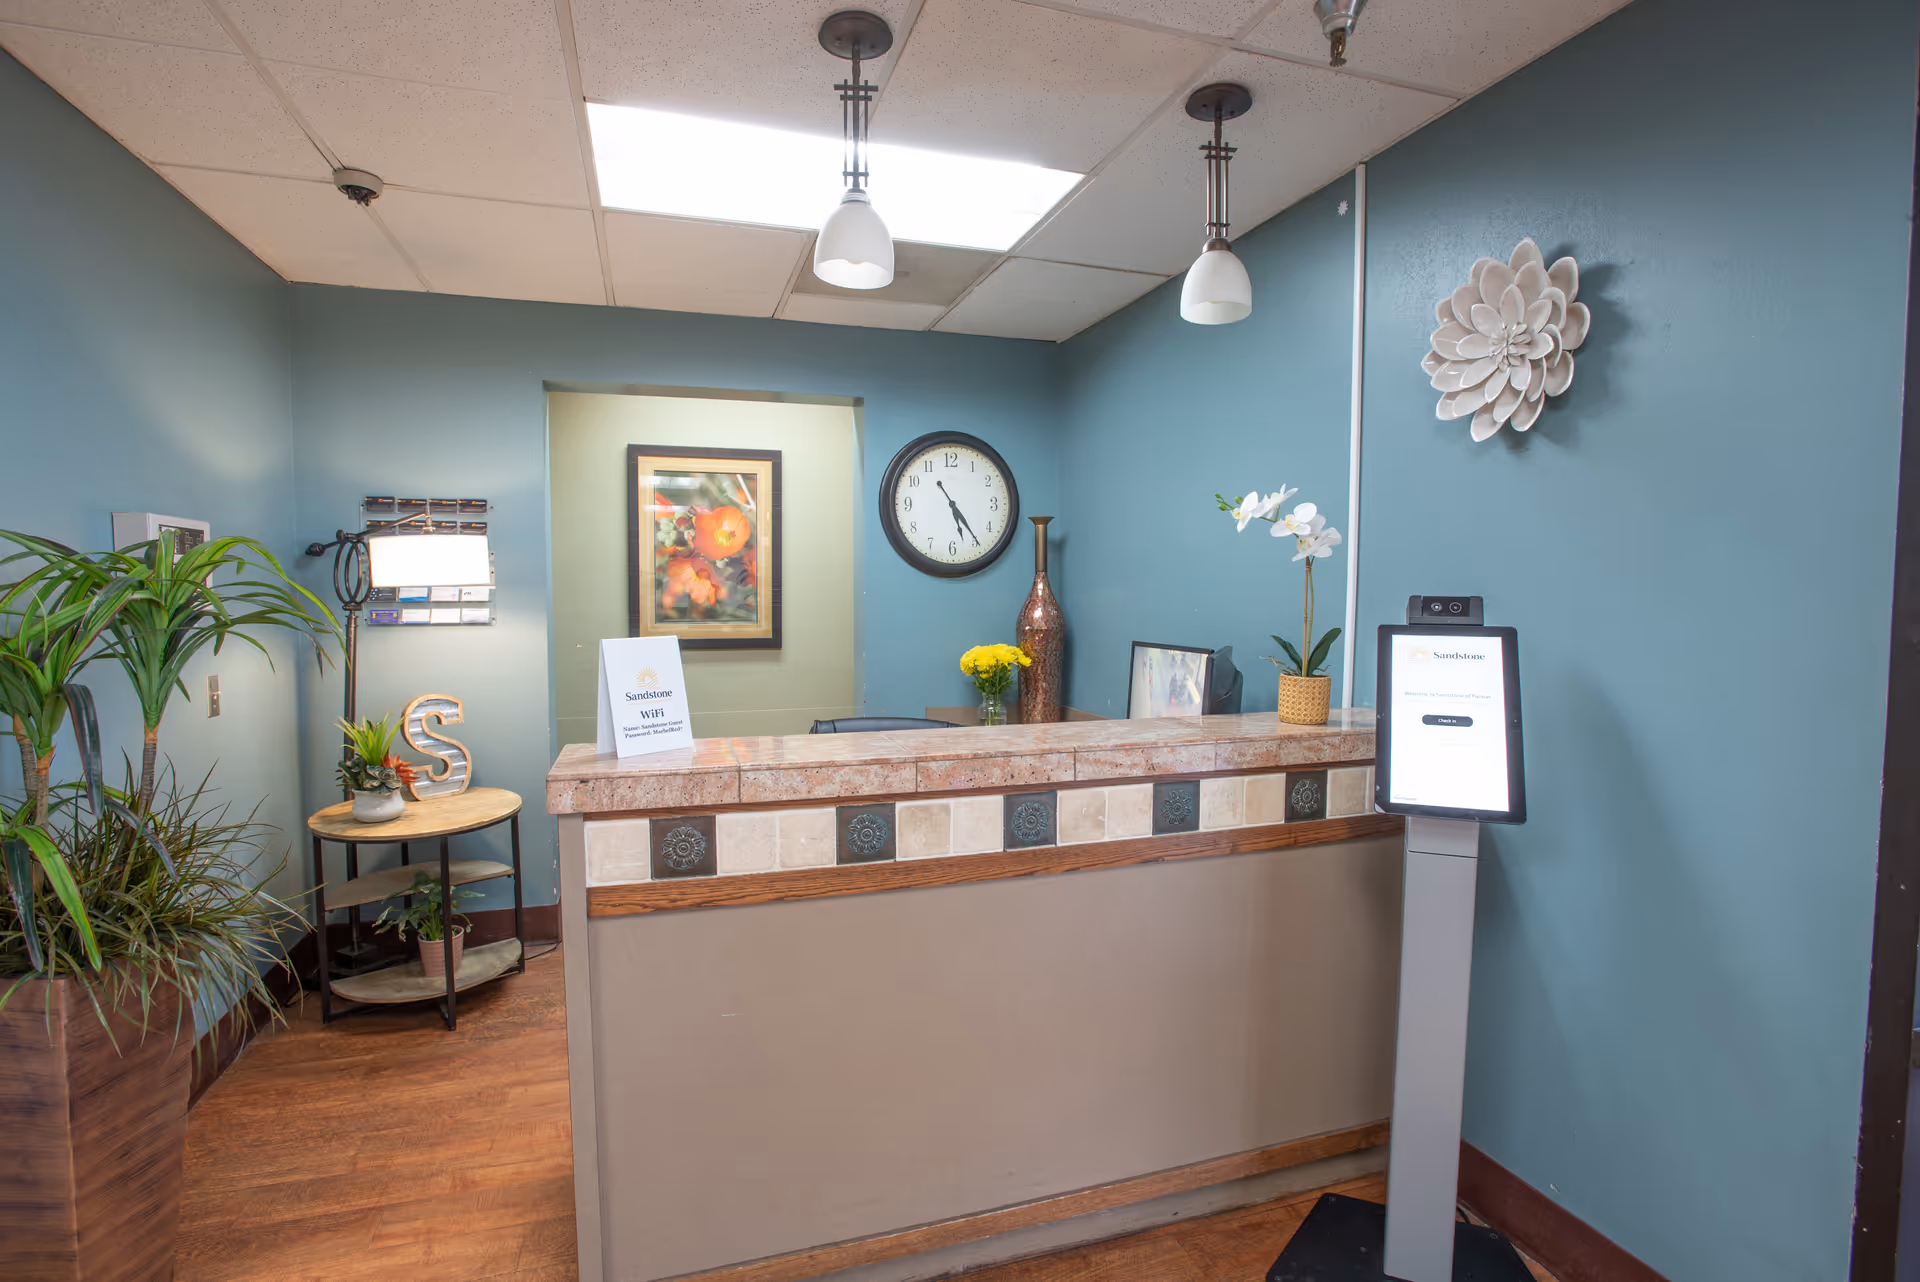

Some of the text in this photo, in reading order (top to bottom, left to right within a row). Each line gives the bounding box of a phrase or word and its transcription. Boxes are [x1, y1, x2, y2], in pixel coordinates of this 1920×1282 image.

[924, 460, 933, 472] 11
[943, 452, 958, 468] 12
[970, 461, 975, 472] 1
[908, 475, 920, 488] 10
[985, 475, 992, 487] 2
[904, 496, 913, 512] 9
[990, 496, 998, 512] 3
[910, 521, 917, 533] 8
[986, 520, 992, 532] 4
[927, 537, 934, 549] 7
[948, 540, 957, 556] 6
[1433, 651, 1486, 660] Sandstone
[625, 689, 673, 702] Sandstone
[640, 708, 665, 720] WiFi
[641, 722, 667, 730] Sandstone
[401, 693, 472, 801] S
